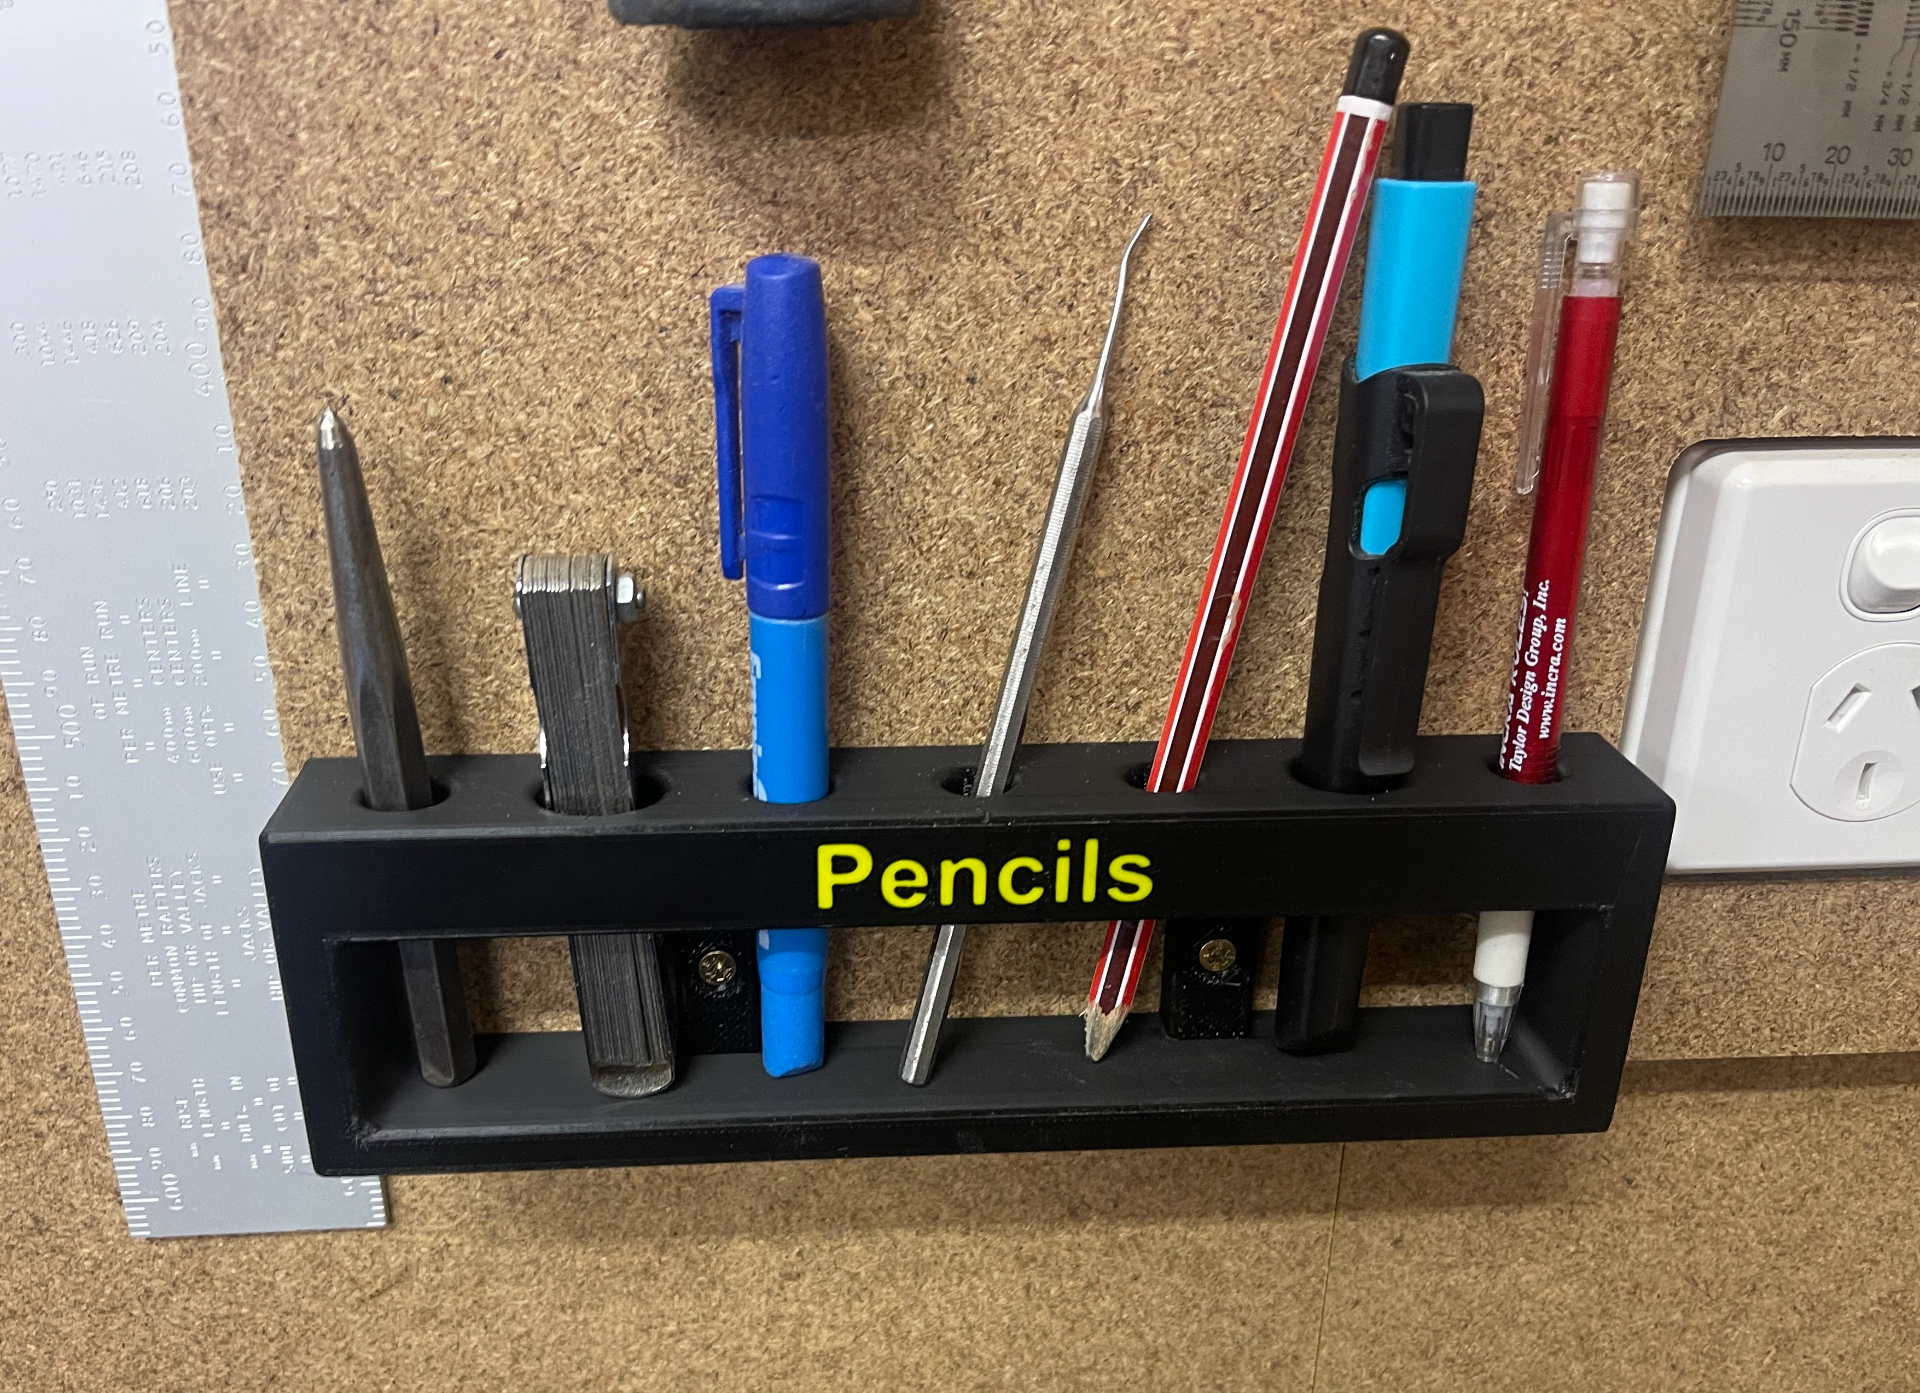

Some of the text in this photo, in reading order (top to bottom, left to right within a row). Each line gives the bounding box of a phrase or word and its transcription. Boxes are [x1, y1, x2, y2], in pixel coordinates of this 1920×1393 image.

[1779, 9, 1802, 48] 150
[1762, 142, 1786, 162] 10
[1824, 145, 1851, 165] 20
[1887, 147, 1913, 167] 30
[185, 341, 214, 398] 400
[214, 425, 234, 455] 10
[4, 498, 24, 529] 60
[15, 557, 36, 586] 70
[171, 563, 194, 607] LINE
[1532, 579, 1550, 611] Inc.
[29, 615, 49, 642] 80
[93, 600, 114, 640] RUN
[243, 600, 262, 629] 40
[136, 597, 165, 686] CENTERS
[157, 598, 186, 686] CENTERS
[1524, 614, 1547, 667] Group,
[41, 669, 61, 697] 90
[80, 646, 100, 684] RUN
[1539, 618, 1566, 739] www.incra.com
[104, 653, 129, 715] METRE
[1516, 671, 1538, 724] Design
[91, 696, 107, 719] OF
[262, 709, 280, 737] 60
[57, 704, 85, 749] 500
[120, 728, 140, 763] PER
[1509, 725, 1527, 771] Taylor
[65, 775, 84, 800] 10
[209, 762, 227, 796] USE
[76, 826, 96, 852] 20
[185, 852, 208, 908] JACKS
[817, 838, 1153, 909] Pencils
[146, 855, 174, 935] RAFTERS
[169, 867, 194, 935] VALLEY
[131, 889, 155, 943] METRE
[199, 920, 214, 941] OF
[99, 924, 116, 948] 40
[185, 944, 200, 966] OR
[164, 945, 190, 1013] COMMON
[205, 951, 229, 1016] LENGTH
[119, 1016, 138, 1041] 60
[129, 1061, 147, 1083] 70
[191, 1078, 215, 1137] LENGTH
[161, 1173, 184, 1210] 600
